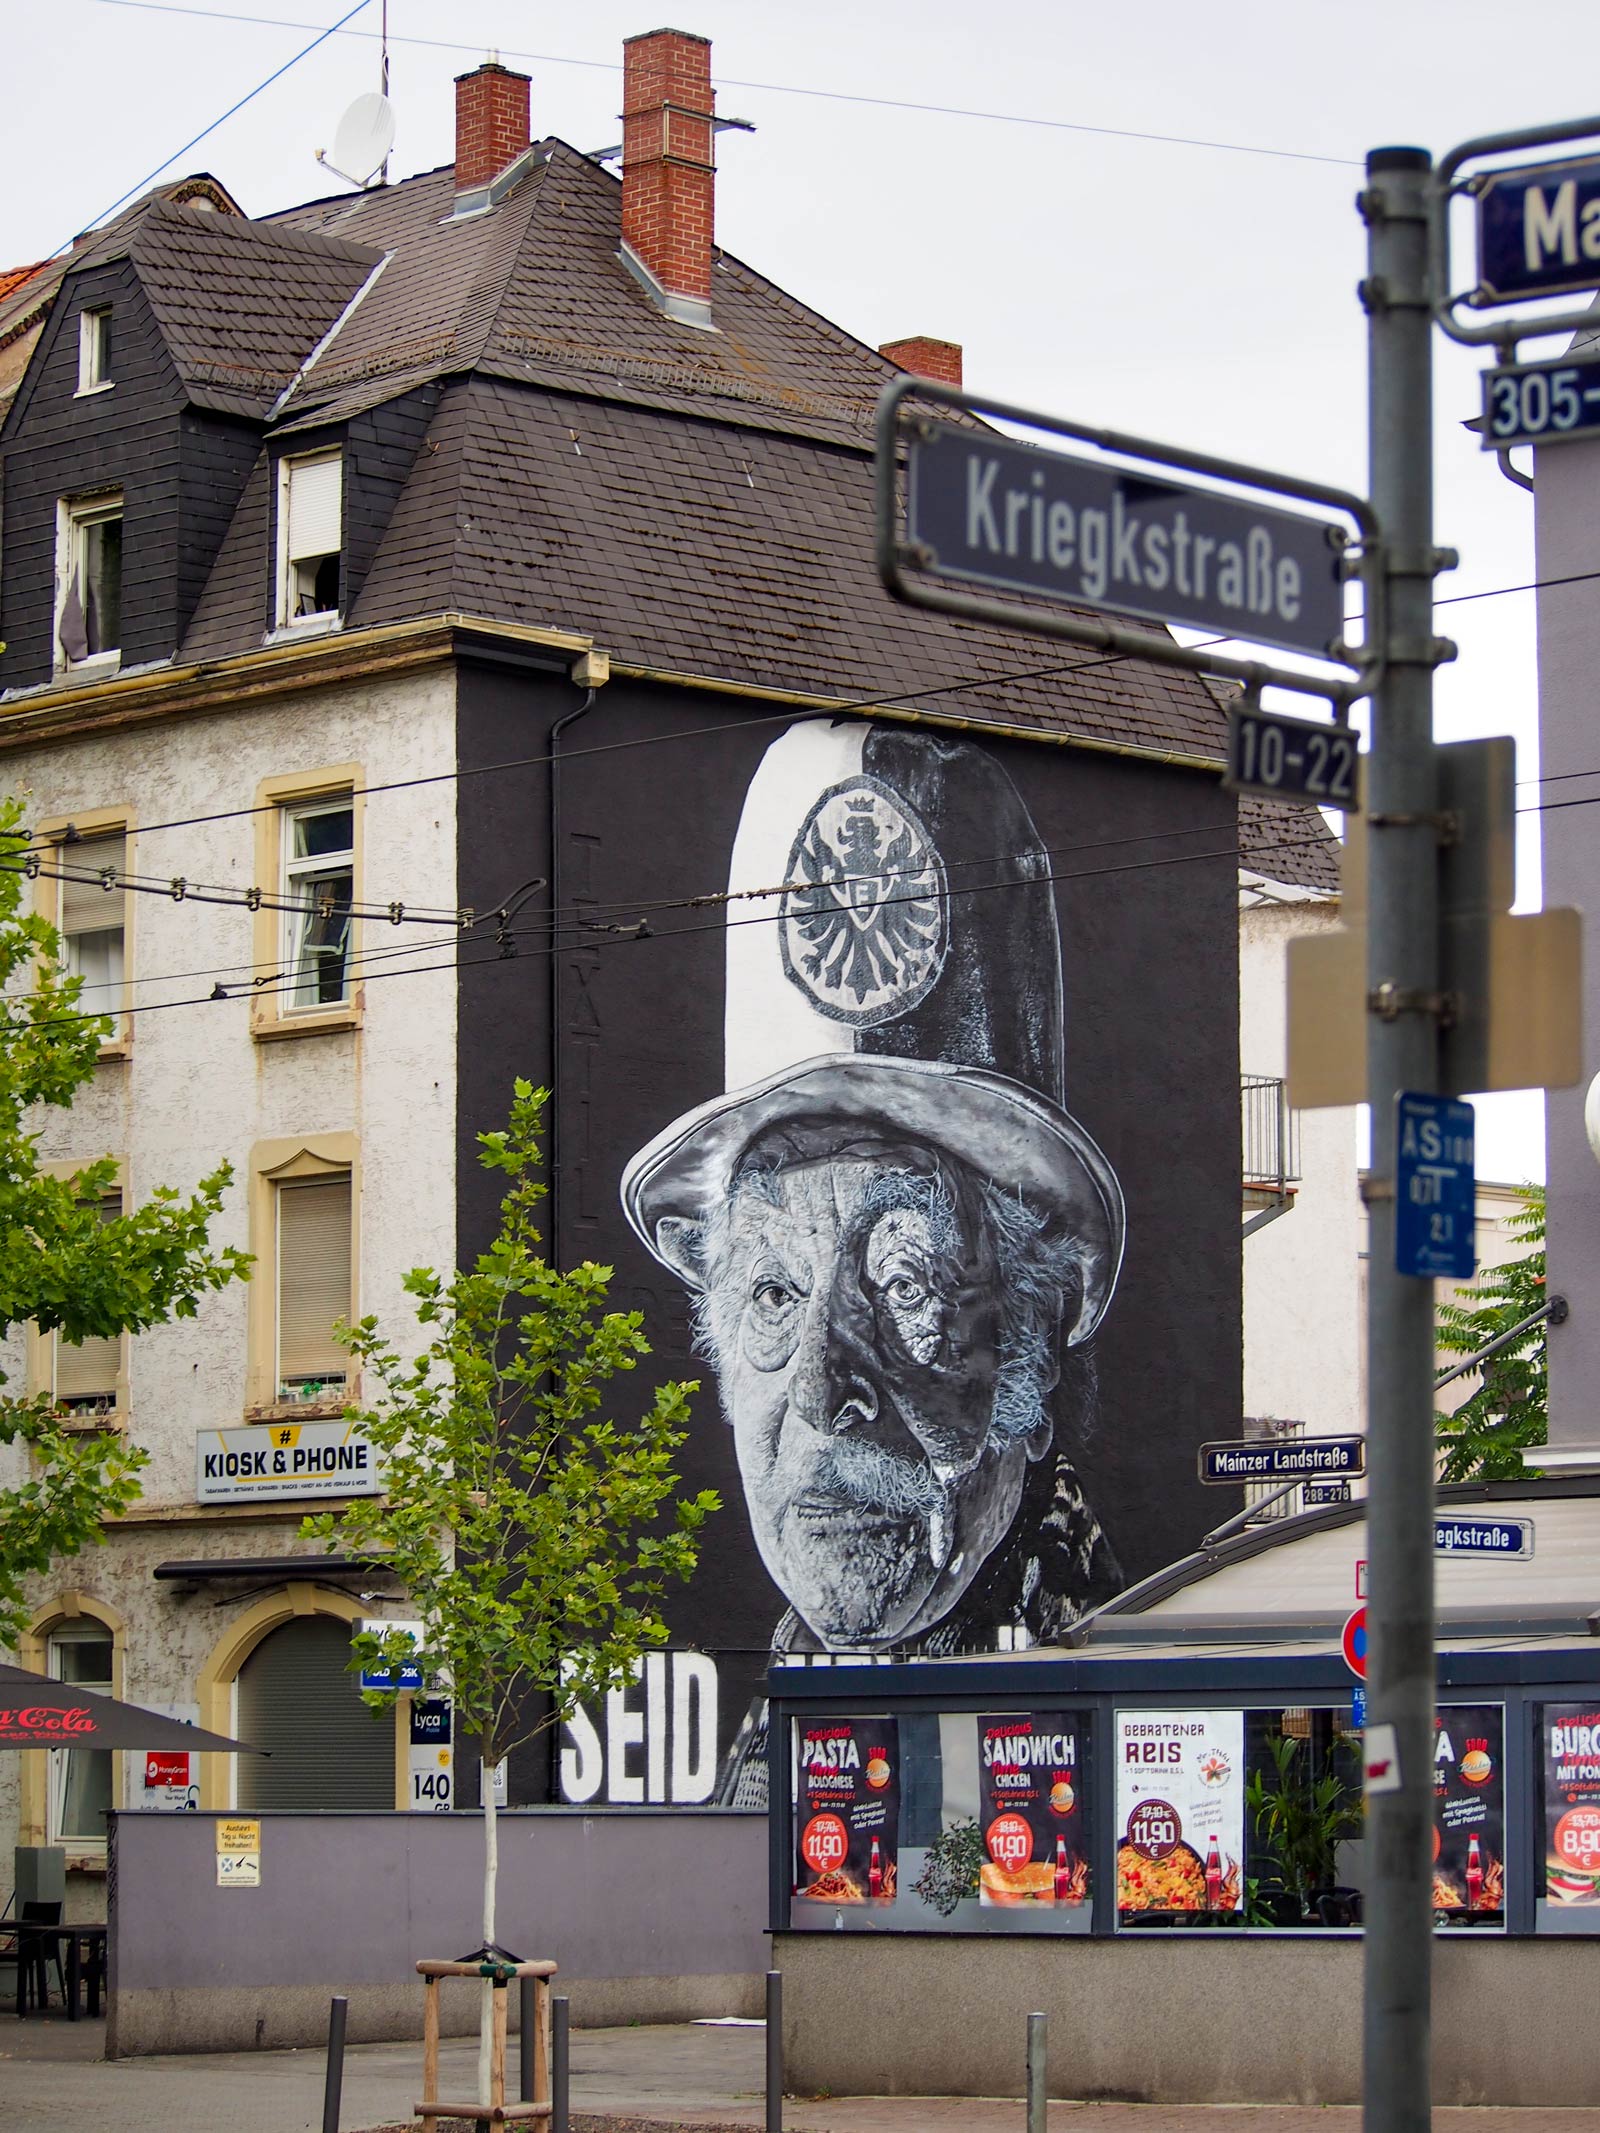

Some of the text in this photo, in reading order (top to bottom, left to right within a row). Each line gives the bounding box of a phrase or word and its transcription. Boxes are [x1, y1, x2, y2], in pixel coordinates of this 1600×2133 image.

[967, 455, 1300, 621] Kriegkstraße
[1241, 721, 1352, 796] 10-22
[280, 1430, 291, 1444] #
[205, 1445, 367, 1478] KIOSK & PHONE
[1215, 1447, 1349, 1472] Mainzer Landstraße
[1304, 1487, 1349, 1502] 288-278
[415, 1712, 440, 1729] Lyca
[560, 1650, 718, 1802] SEID
[802, 1738, 860, 1768] PASTA
[983, 1735, 1075, 1767] SANDWICH
[808, 1775, 854, 1788] BOLOGNESE
[996, 1773, 1031, 1788] CHICKEN
[1557, 1765, 1576, 1780] MIT
[415, 1774, 450, 1800] 140
[1132, 1821, 1174, 1847] 11,90
[808, 1835, 842, 1860] 11,90
[991, 1835, 1026, 1861] 11,90
[1150, 1845, 1158, 1856] €
[1582, 1854, 1591, 1866] €
[821, 1858, 828, 1869] €
[1006, 1859, 1013, 1870] €
